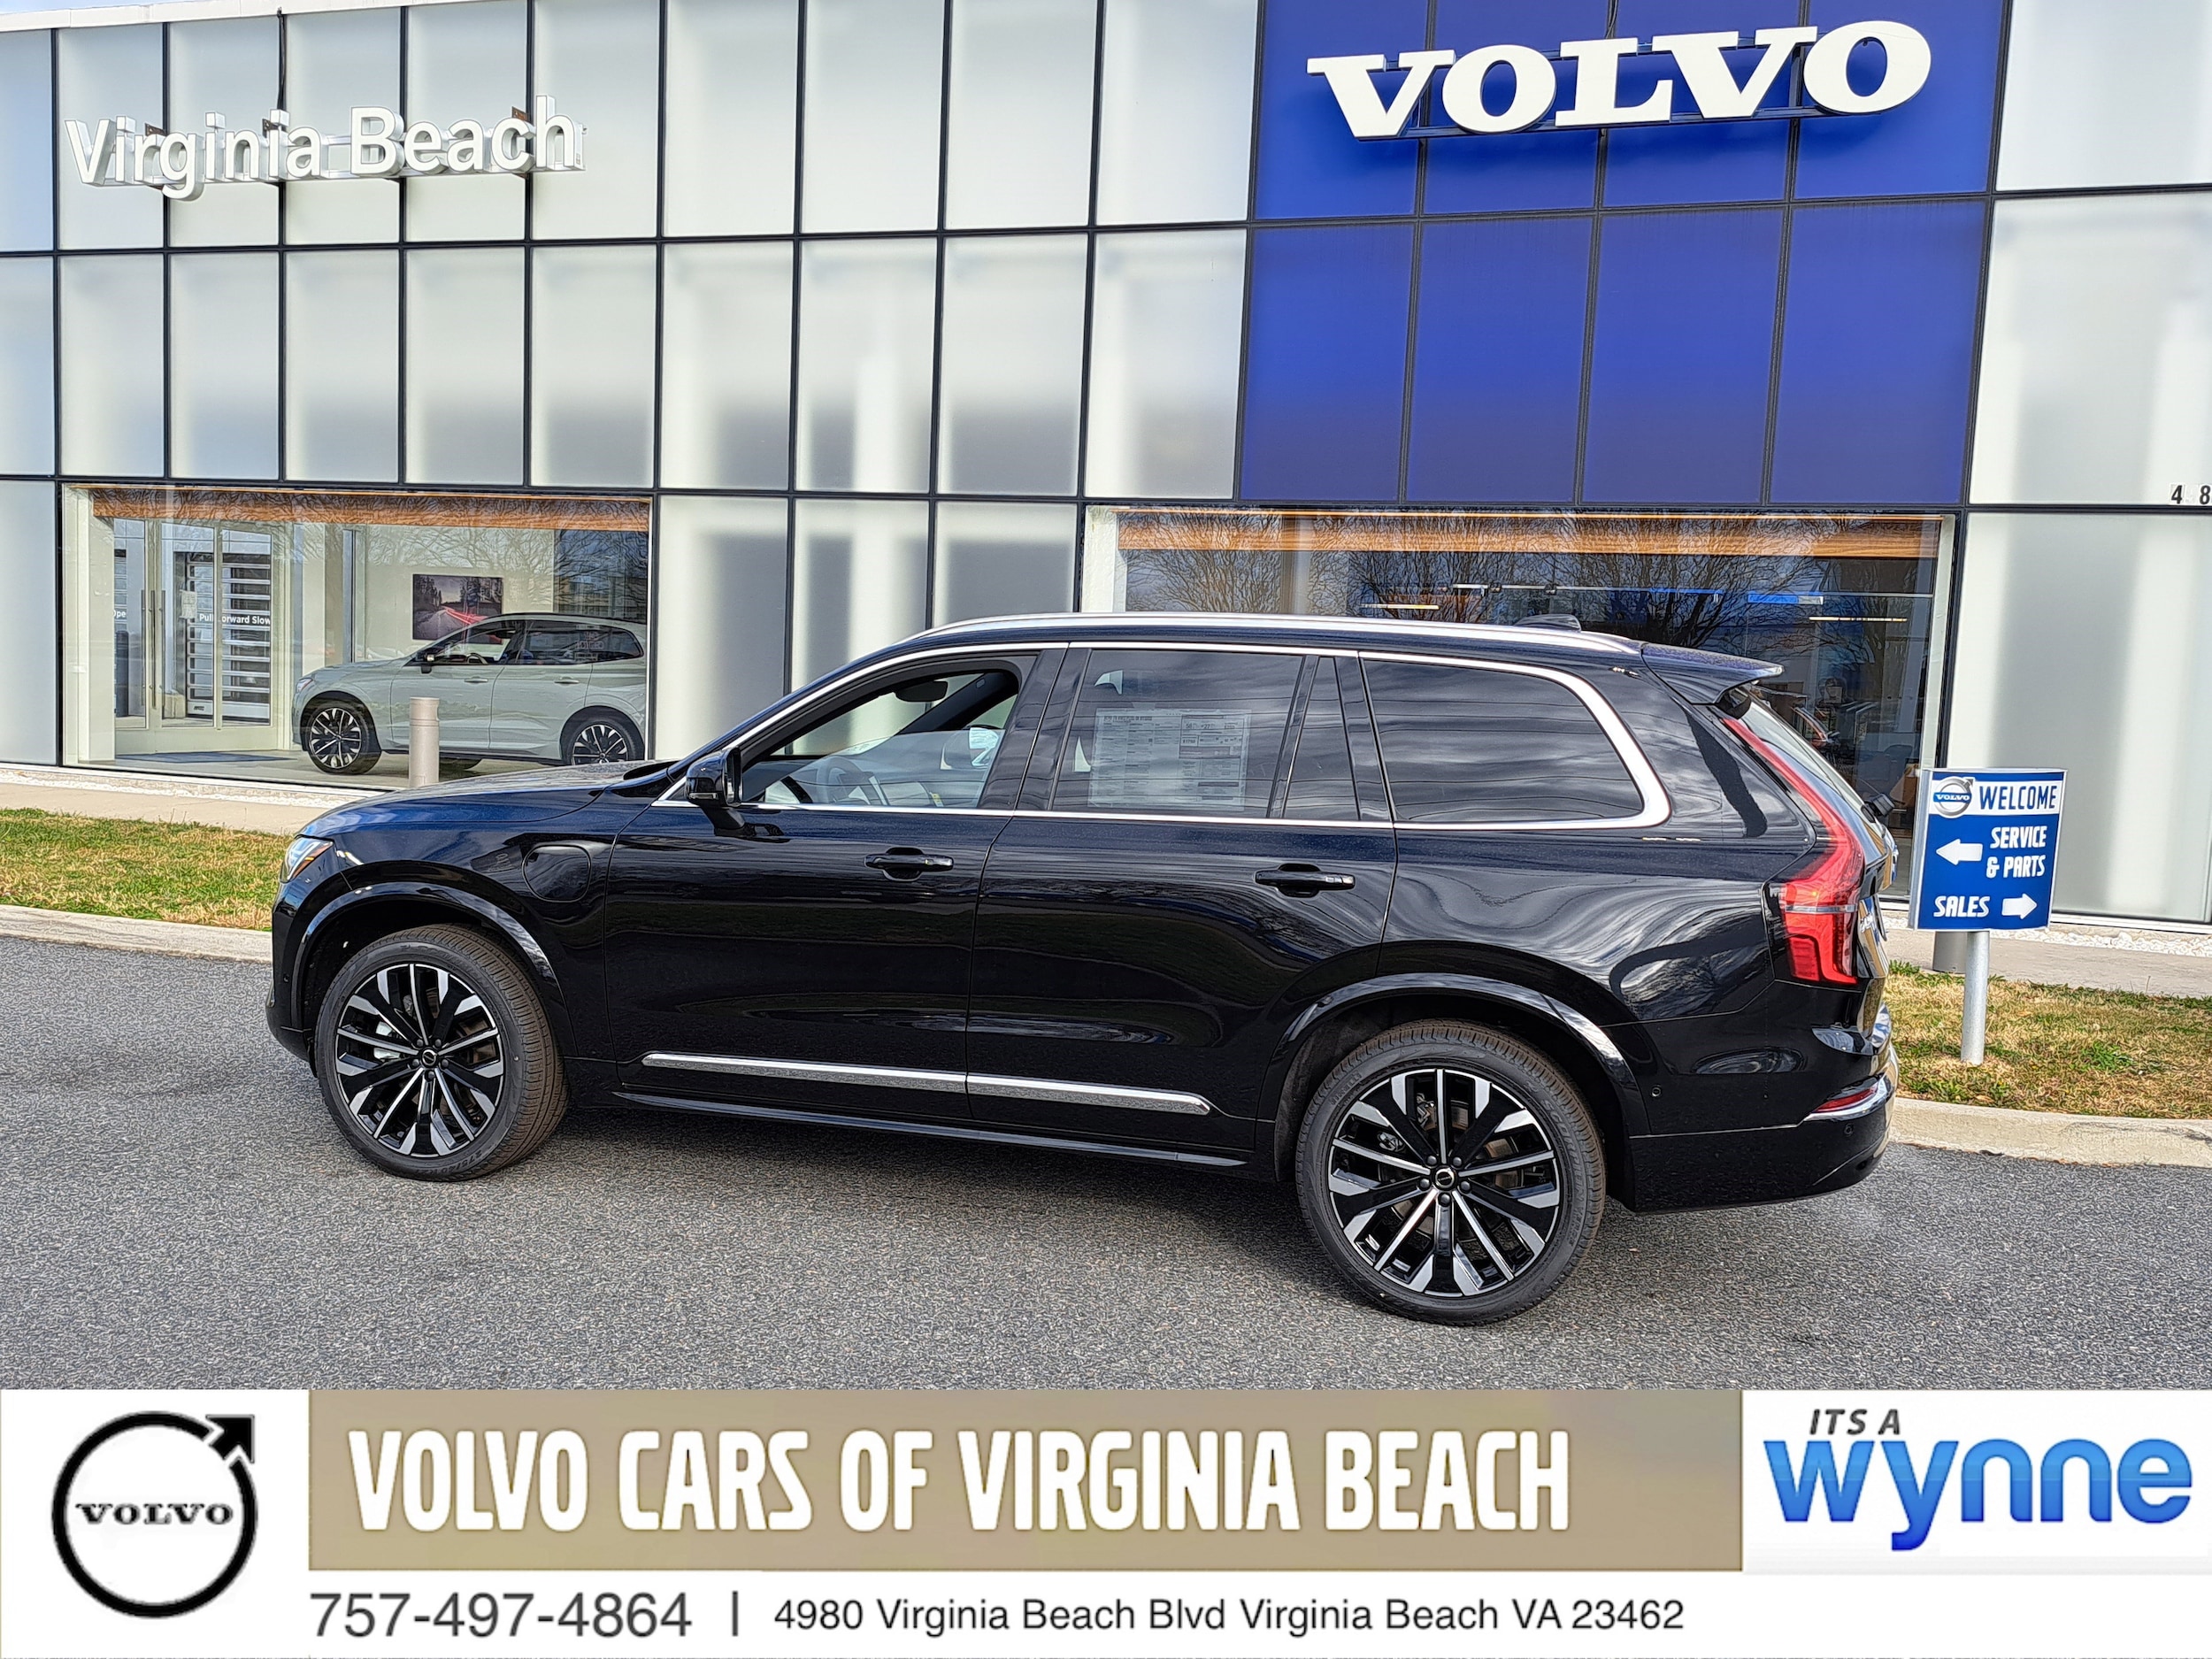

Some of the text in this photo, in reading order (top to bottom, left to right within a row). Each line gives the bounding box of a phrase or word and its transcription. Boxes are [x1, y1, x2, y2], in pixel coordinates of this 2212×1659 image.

[1307, 20, 1932, 137] VOLVO
[65, 95, 580, 201] Virginia Beach
[199, 613, 213, 622] Pull
[222, 615, 250, 624] orward
[1979, 785, 2058, 810] WELCOME
[1990, 826, 2047, 849] SERVICE
[1985, 855, 2047, 878] & PARTS
[1933, 895, 1991, 918] SALES
